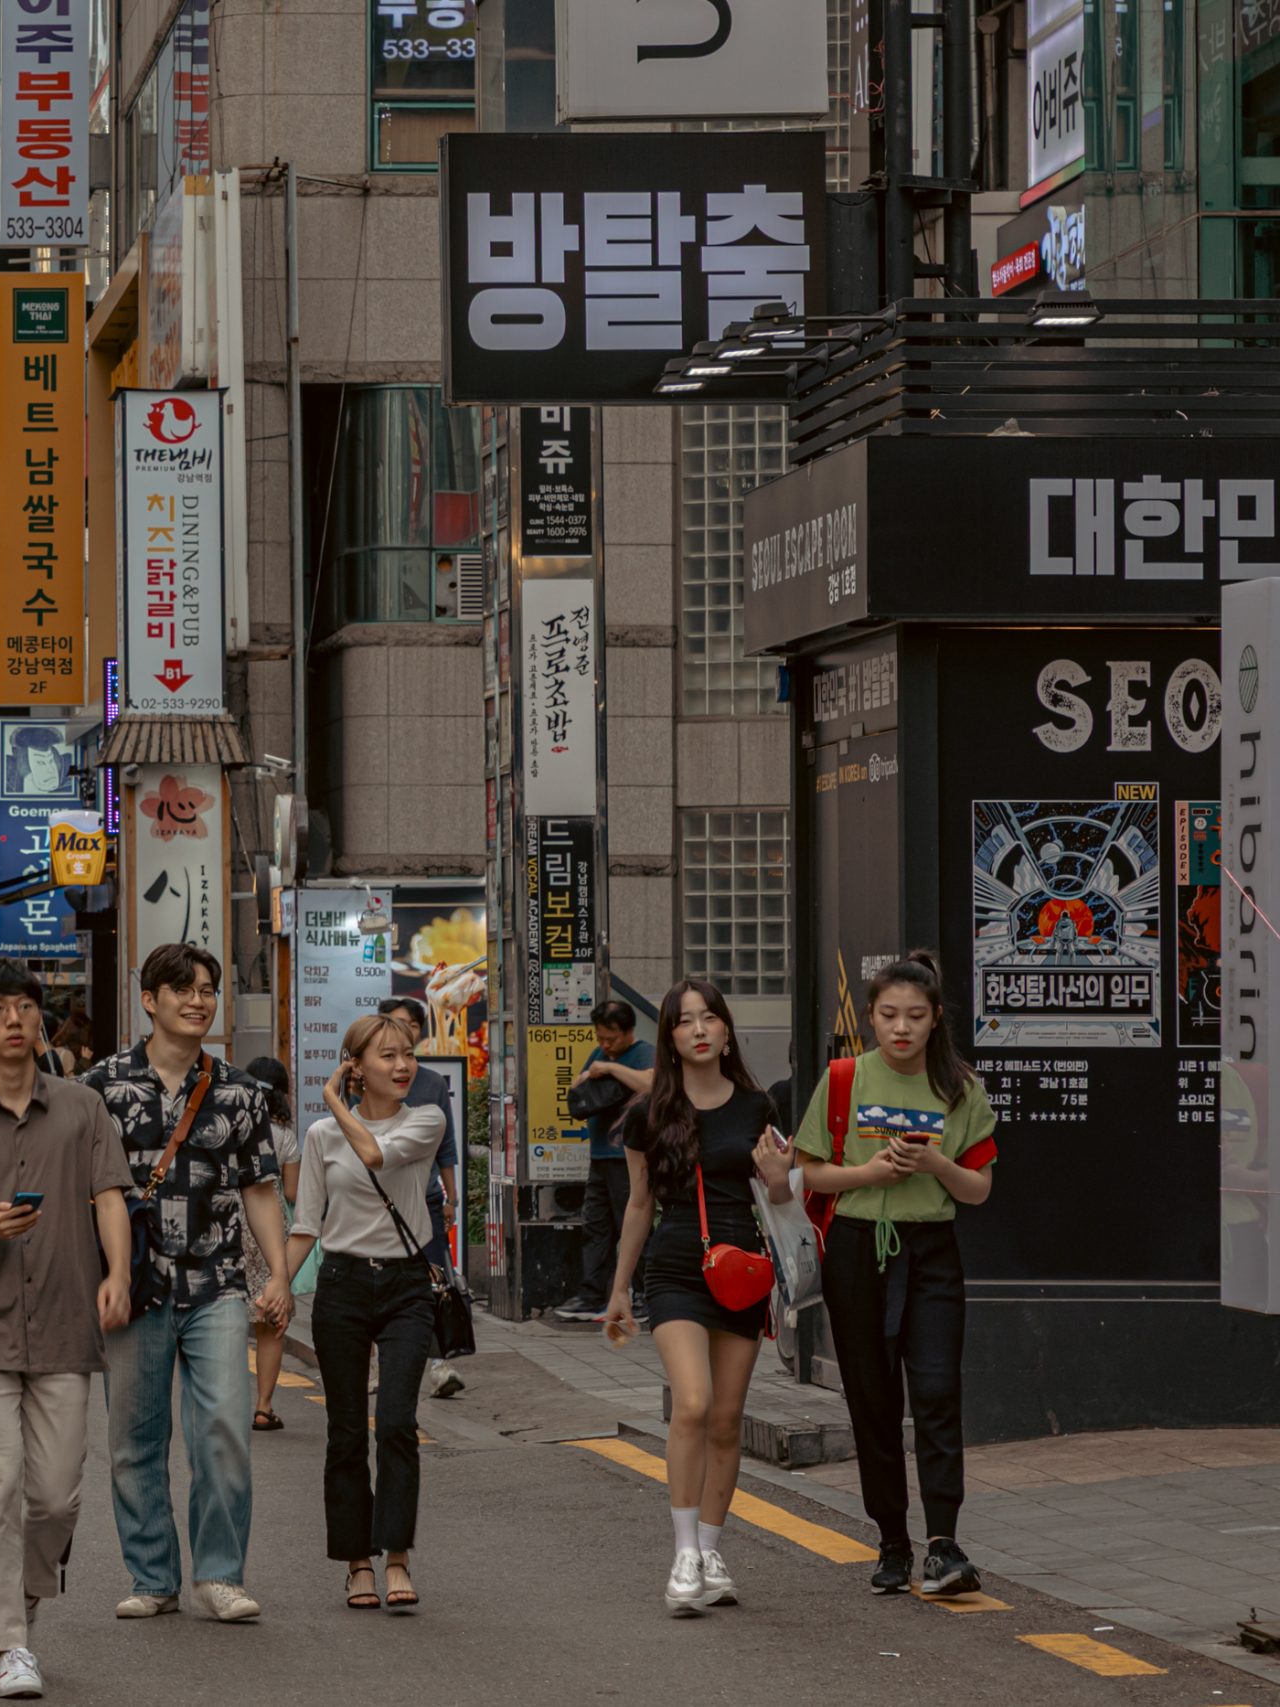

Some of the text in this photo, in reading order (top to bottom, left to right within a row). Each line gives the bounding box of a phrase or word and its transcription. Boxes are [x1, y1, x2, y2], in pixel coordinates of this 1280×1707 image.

[1033, 51, 1085, 149] 아비쥬
[6, 216, 84, 240] 533-3304
[467, 184, 811, 351] 방탈출
[22, 302, 60, 312] MEKONG
[29, 311, 52, 321] THAI
[177, 473, 213, 483] 강남역점
[22, 353, 59, 627] 베트남쌀국수
[751, 503, 858, 592] SEOUL ESCAPE ROOM
[182, 494, 200, 647] DINING&PUB
[6, 635, 73, 654] 메콩타이
[7, 657, 73, 676] 강남역점
[165, 667, 183, 680] B1
[541, 614, 573, 743] 프로초밥
[29, 681, 48, 694] 2F
[849, 663, 862, 713] #1
[141, 697, 221, 711] 02-533-9290
[1118, 785, 1156, 800] NEW
[156, 827, 198, 837] IZAKAYA
[55, 832, 102, 852] Max
[1179, 808, 1187, 881] EPISODE X
[66, 852, 92, 861] Cream
[72, 861, 85, 875] 生
[527, 857, 539, 896] VOCAL
[1240, 730, 1262, 1061] hibarin
[200, 864, 209, 946] IZAKAY
[305, 911, 347, 928] 더냄비
[528, 898, 539, 955] ACADEMY
[305, 930, 361, 947] 식사메뉴
[575, 947, 593, 958] 10F
[1110, 973, 1150, 1008] 임무
[528, 1029, 596, 1043] 1661-554
[975, 1060, 994, 1072] 시즌
[995, 1060, 1003, 1072] 2
[1004, 1060, 1041, 1072] 에피소드
[1043, 1060, 1052, 1072] X
[1178, 1060, 1197, 1072] 시즌
[1199, 1060, 1205, 1072] 1
[1039, 1077, 1060, 1089] 강남
[987, 1094, 1012, 1106] 요시간
[1178, 1094, 1215, 1106] 소요시간
[532, 1126, 558, 1141] 12층
